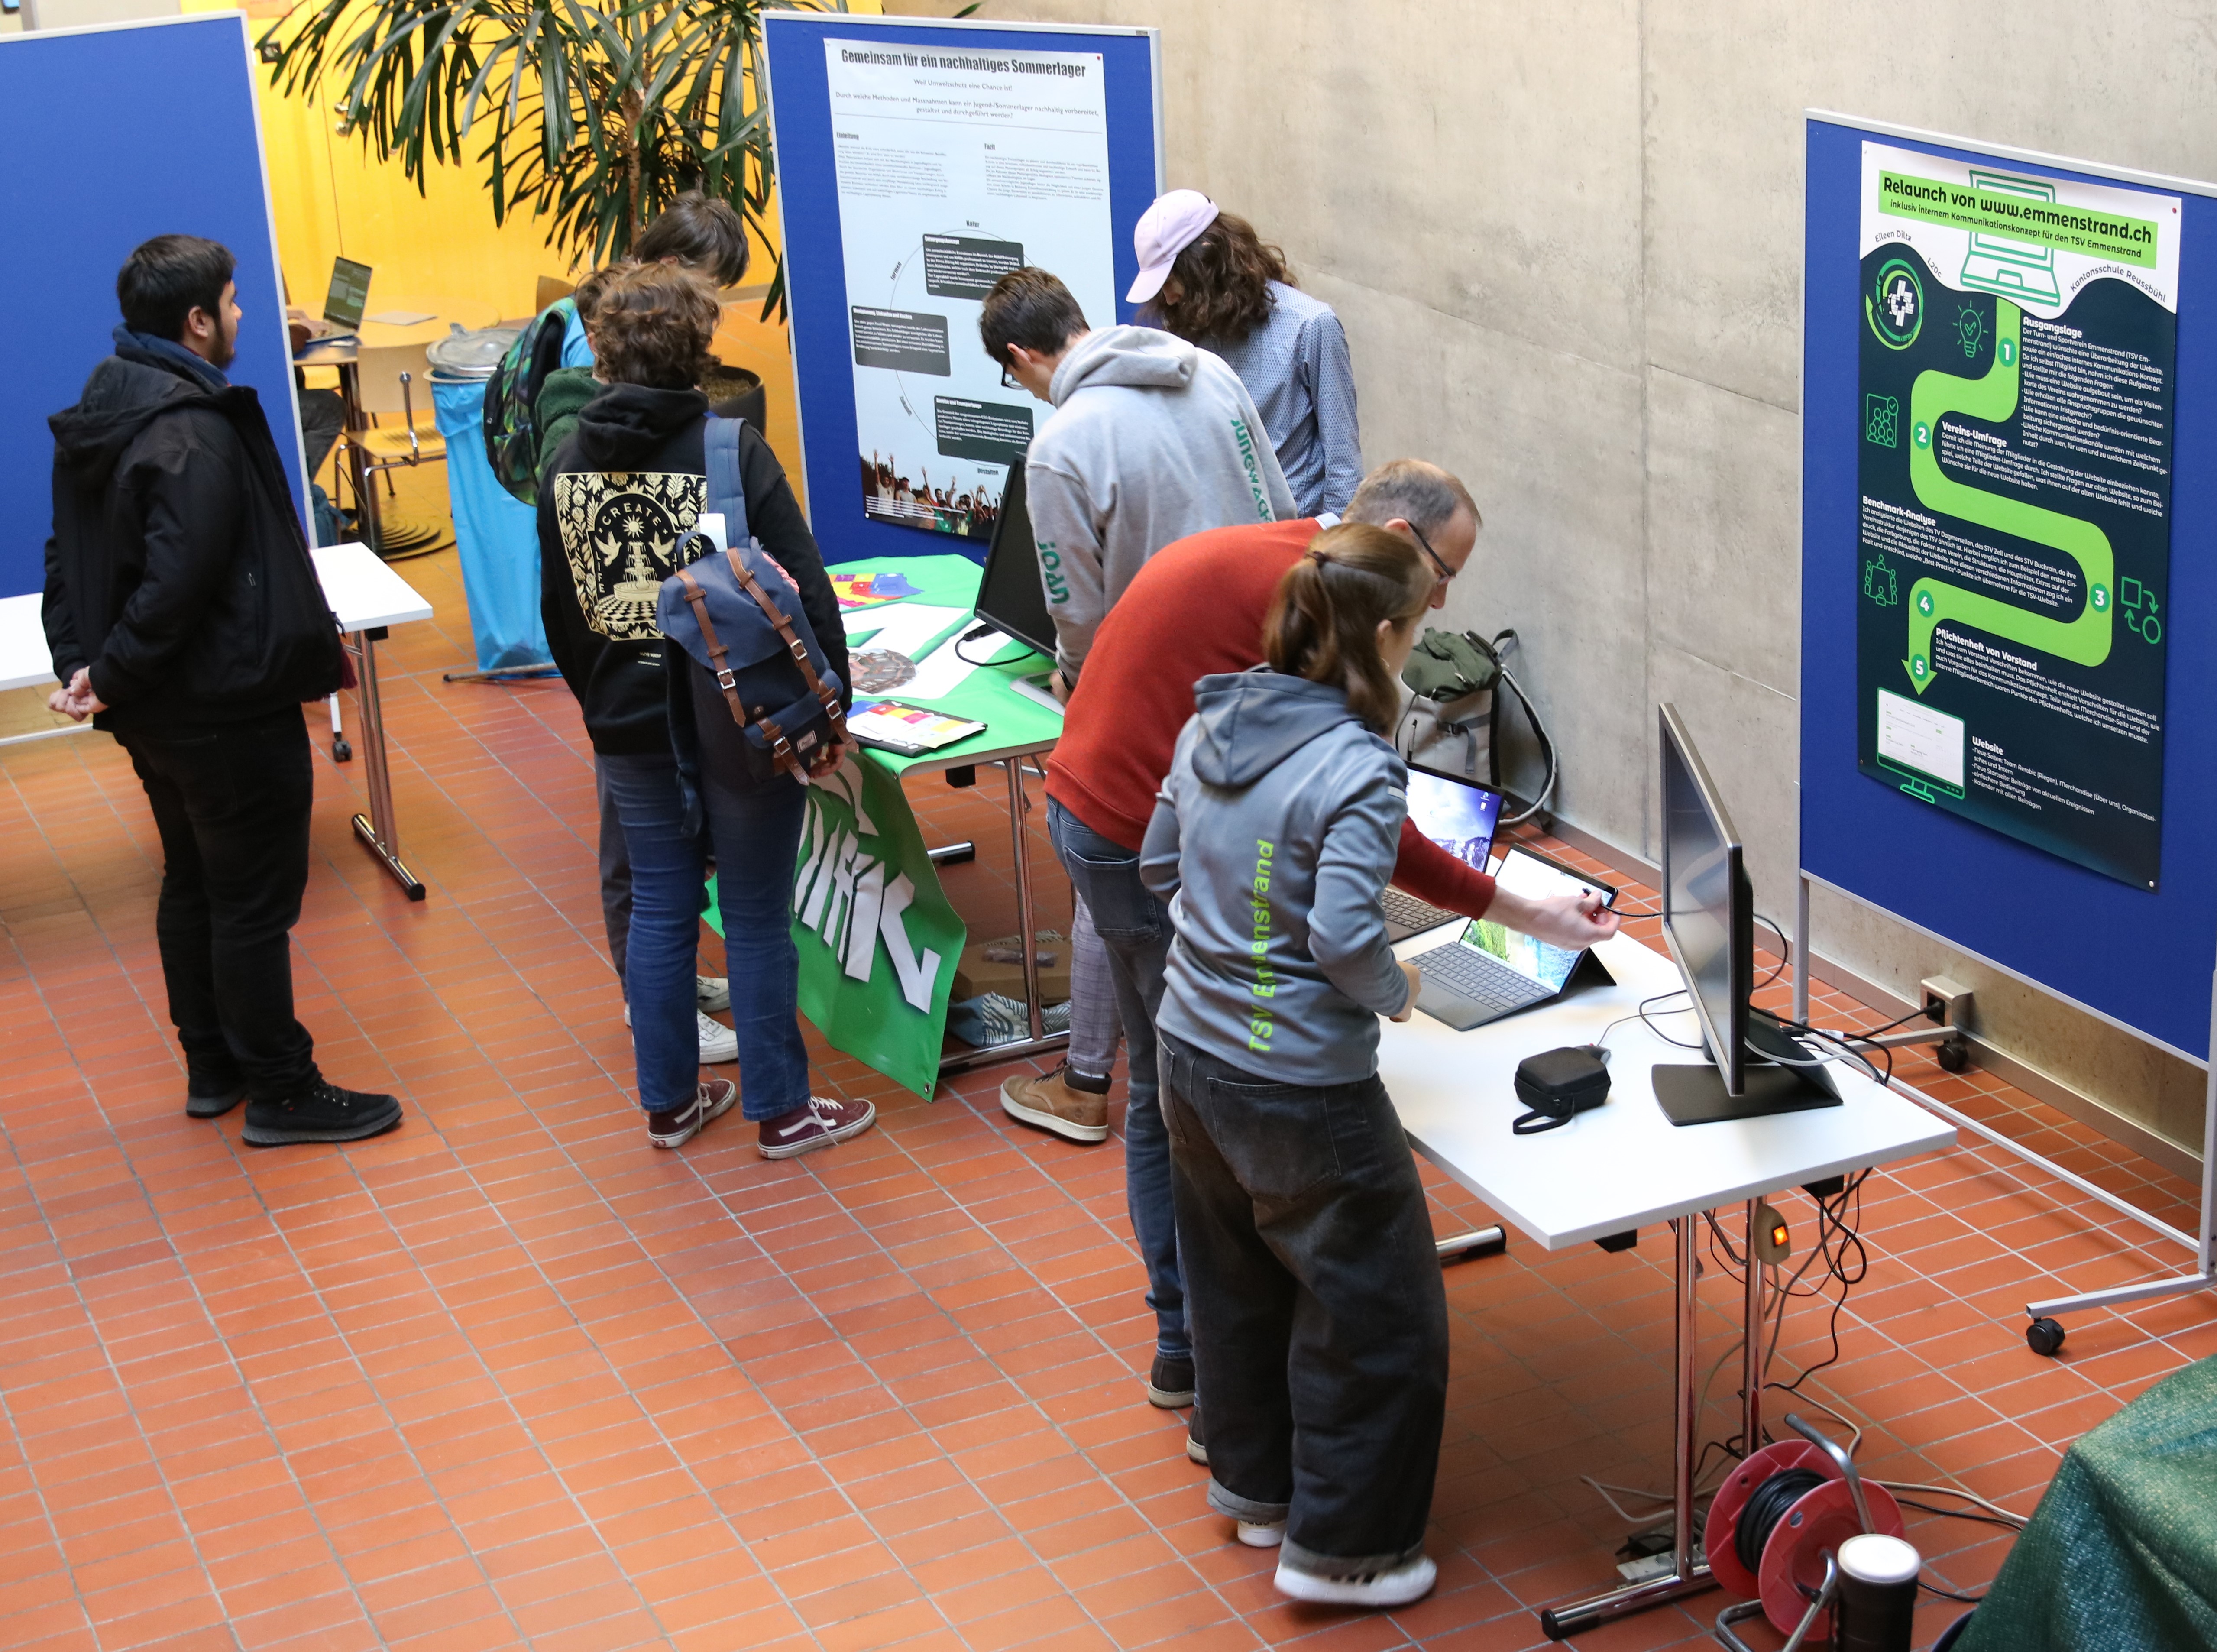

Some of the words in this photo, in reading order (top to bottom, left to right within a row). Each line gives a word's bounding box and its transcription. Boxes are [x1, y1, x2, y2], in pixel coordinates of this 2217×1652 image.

[842, 49, 901, 65] Gemeinsam
[903, 53, 918, 66] für
[921, 54, 937, 67] ein
[939, 56, 1009, 72] nachhaltiges
[1011, 59, 1086, 77] Sommerlager
[1884, 177, 1946, 202] Relaunch
[1951, 193, 1975, 208] von
[1980, 199, 2151, 243] www.emmenstrand.ch
[1875, 231, 1894, 243] Eileen
[1896, 230, 1912, 243] Diltz
[1890, 199, 1917, 211] inklusiv
[1919, 204, 1949, 218] internem
[1951, 212, 2040, 237] Kommunikationskonzept
[2042, 230, 2052, 239] für
[2055, 233, 2068, 243] den
[2070, 236, 2085, 246] TSV
[2087, 240, 2141, 257] Emmenstrand
[1927, 257, 1942, 278] L20c
[2070, 264, 2124, 292] Kantonsschule
[2126, 270, 2167, 303] Reussbühl
[2023, 316, 2082, 339] Ausgangslage
[2004, 344, 2010, 360] 1
[2046, 351, 2071, 361] einfaches
[2071, 356, 2093, 366] internes
[2052, 344, 2077, 354] wünschte
[2090, 351, 2128, 368] Überarbeitung
[2058, 336, 2087, 347] Sportverein
[2088, 343, 2125, 356] Emmenstrand
[2033, 365, 2048, 373] stellte
[2067, 373, 2093, 384] folgenden
[2055, 361, 2076, 372] Mitglied
[2113, 376, 2127, 384] diese
[2128, 379, 2152, 390] Aufgabe
[1918, 427, 1926, 443] 2
[1942, 421, 2007, 447] Vereins-Umfrage
[1942, 432, 1957, 441] Damit
[1973, 441, 1996, 453] Meinung
[2005, 450, 2031, 462] Mitglieder
[2046, 462, 2074, 476] Gestaltung
[2084, 472, 2106, 483] Website
[2107, 479, 2139, 492] einbeziehen
[1942, 440, 1956, 449] führte
[2049, 472, 2065, 480] stellte
[2066, 476, 2084, 486] Fragen
[2094, 484, 2108, 492] alten
[602, 502, 661, 526] CREATE
[1863, 496, 1936, 526] Benchmark-Analyse
[1871, 509, 1895, 521] analysierte
[1903, 519, 1925, 530] Websiten
[1994, 548, 2003, 556] Zell
[596, 551, 605, 593] LIFE
[1920, 596, 1929, 612] 4
[2095, 590, 2104, 606] 3
[1936, 627, 1984, 652] Pflichtenheft
[1985, 647, 2000, 658] von
[2001, 651, 2037, 671] Vorstand
[1916, 660, 1924, 675] 5
[1944, 641, 1956, 650] habe
[1968, 649, 1988, 661] Vorstand
[1989, 657, 2017, 671] Vorschriften
[2080, 690, 2101, 701] Website
[2102, 698, 2125, 710] gestaltet
[2126, 706, 2146, 717] werden
[1972, 736, 2003, 755] Website
[1248, 1006, 1274, 1051] TSV
